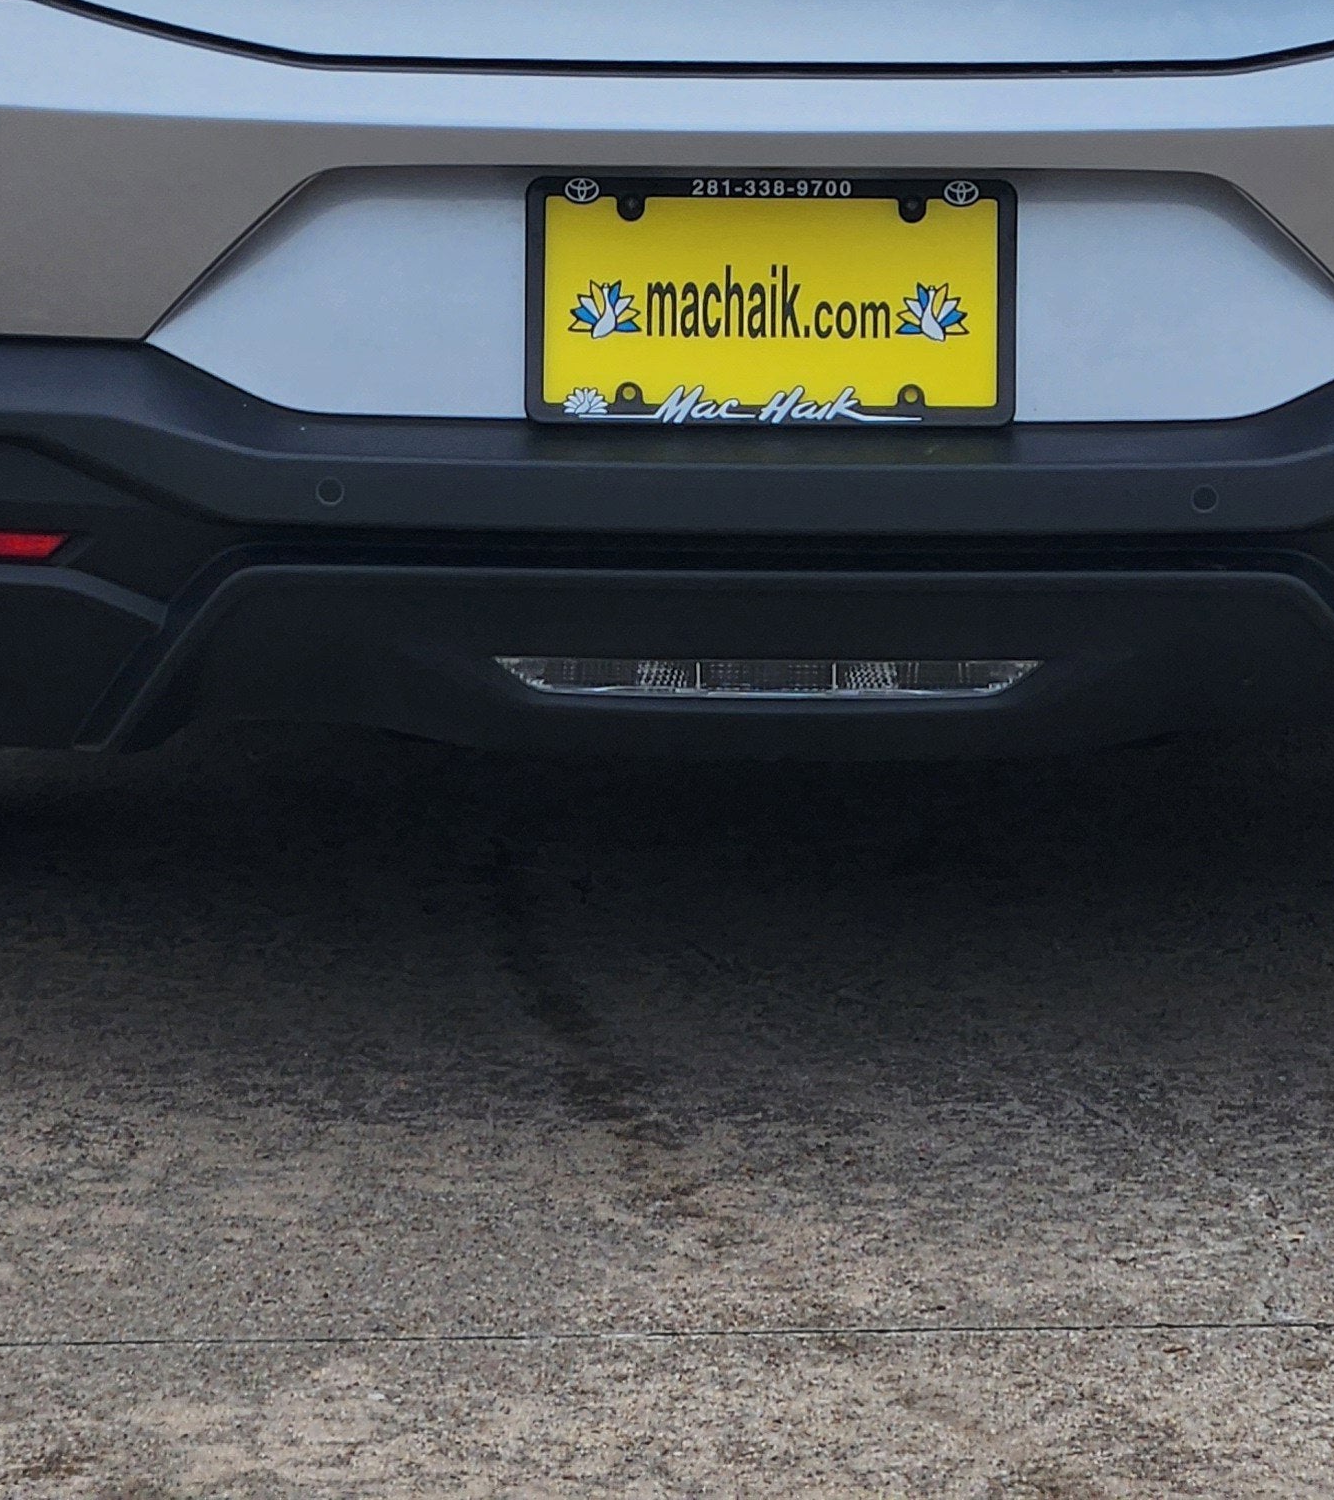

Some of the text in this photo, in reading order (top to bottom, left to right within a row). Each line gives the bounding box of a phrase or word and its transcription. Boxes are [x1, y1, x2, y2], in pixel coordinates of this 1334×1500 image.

[691, 178, 853, 197] 281-338-9700
[646, 264, 892, 339] machaik.com
[651, 384, 872, 424] Mac Haik
